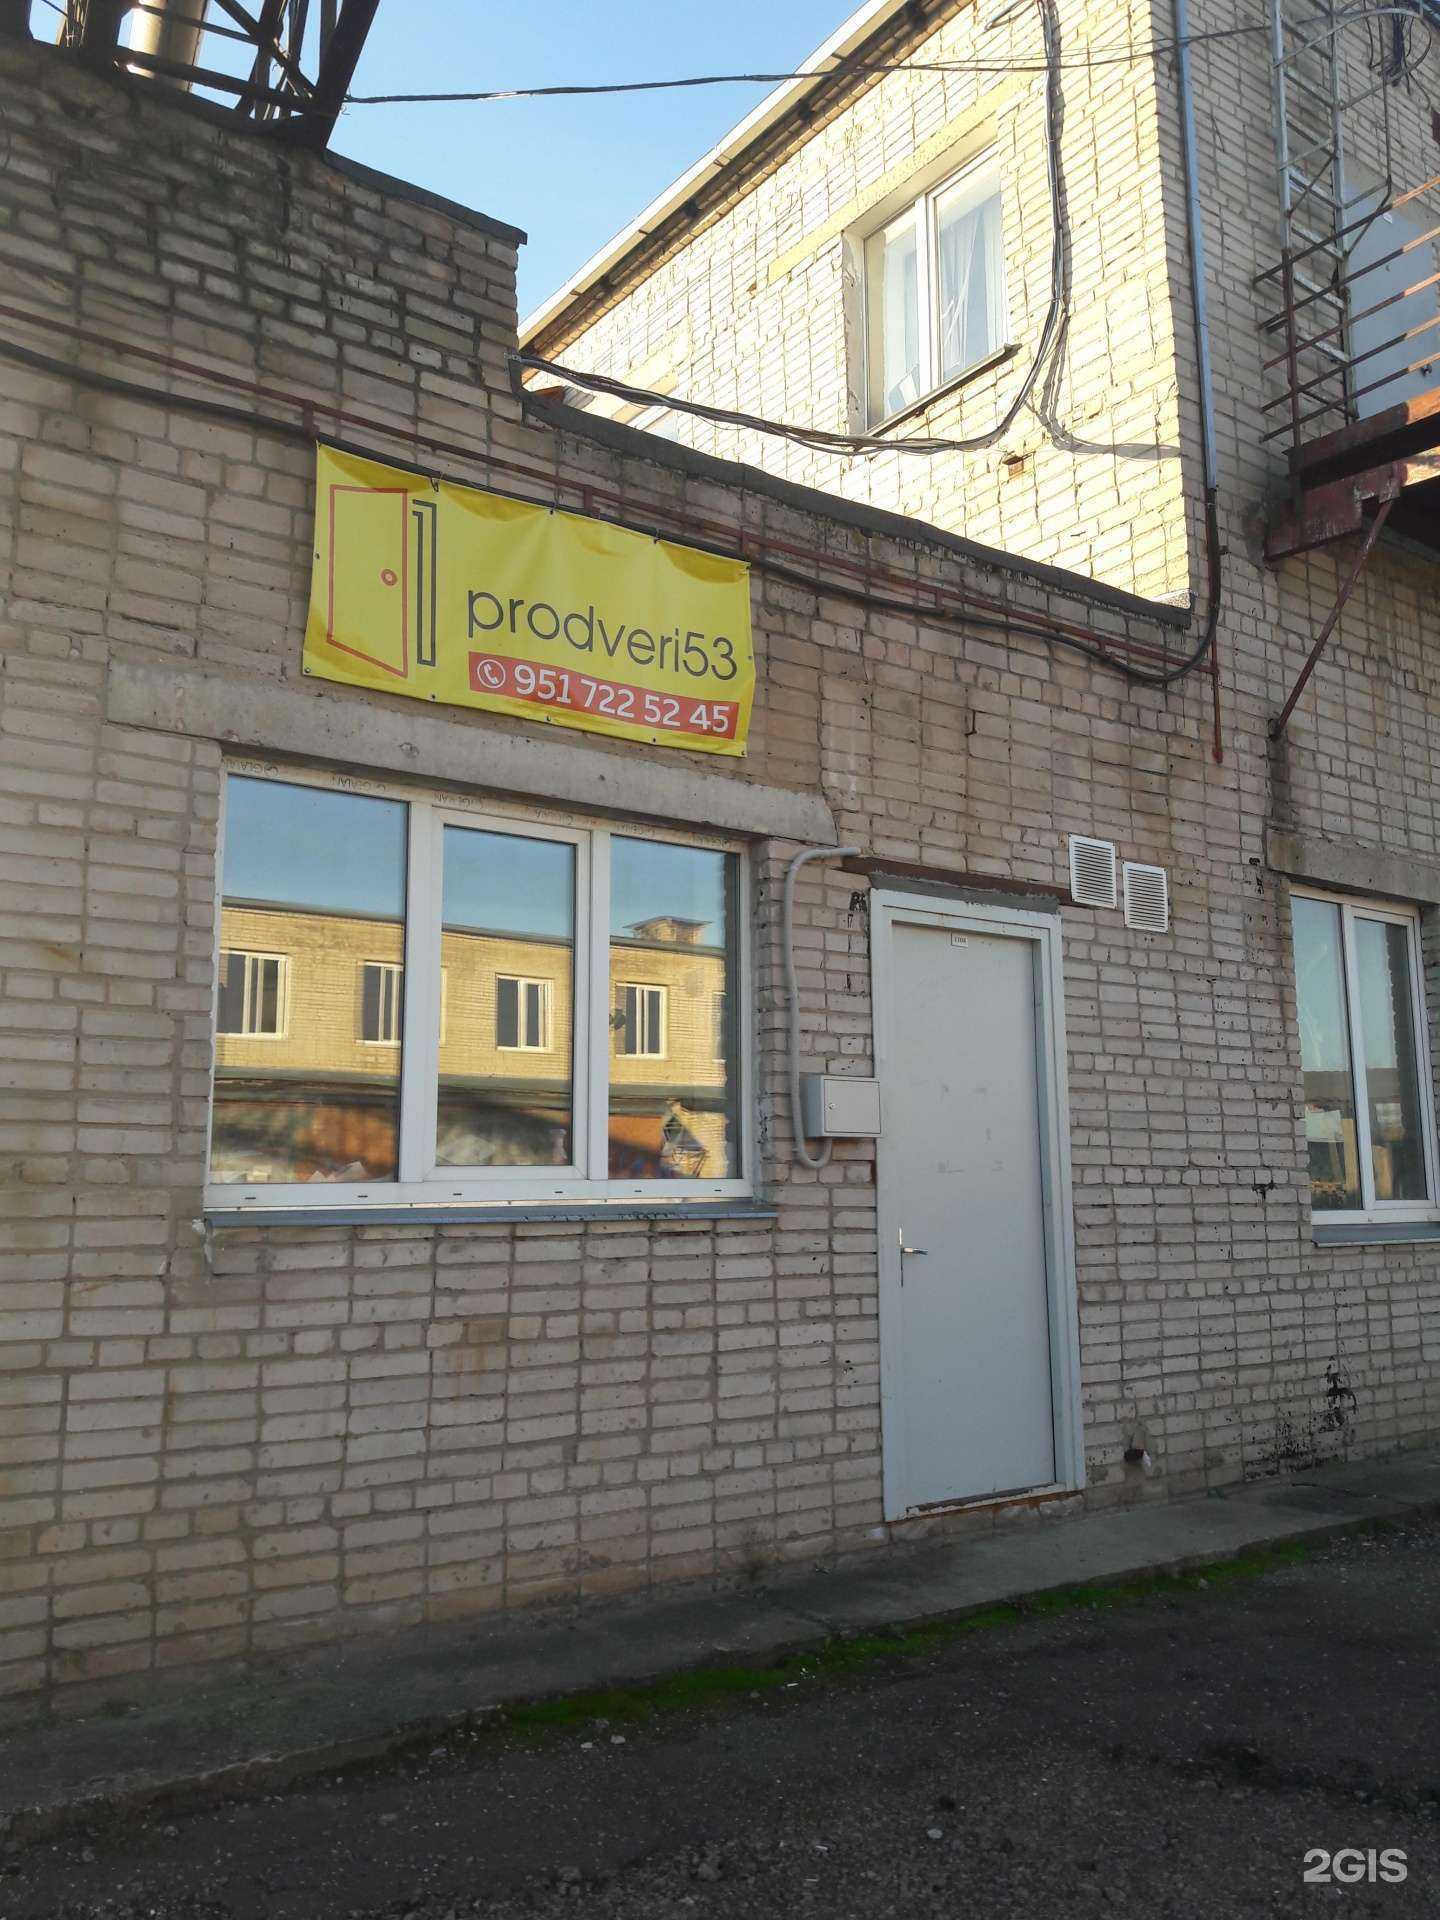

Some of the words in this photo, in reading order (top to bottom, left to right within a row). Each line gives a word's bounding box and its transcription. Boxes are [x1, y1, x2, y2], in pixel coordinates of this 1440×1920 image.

[468, 590, 738, 681] prodveri53
[514, 664, 572, 704] 951
[580, 678, 635, 719] 722
[644, 694, 681, 727] 52
[689, 704, 730, 733] 45
